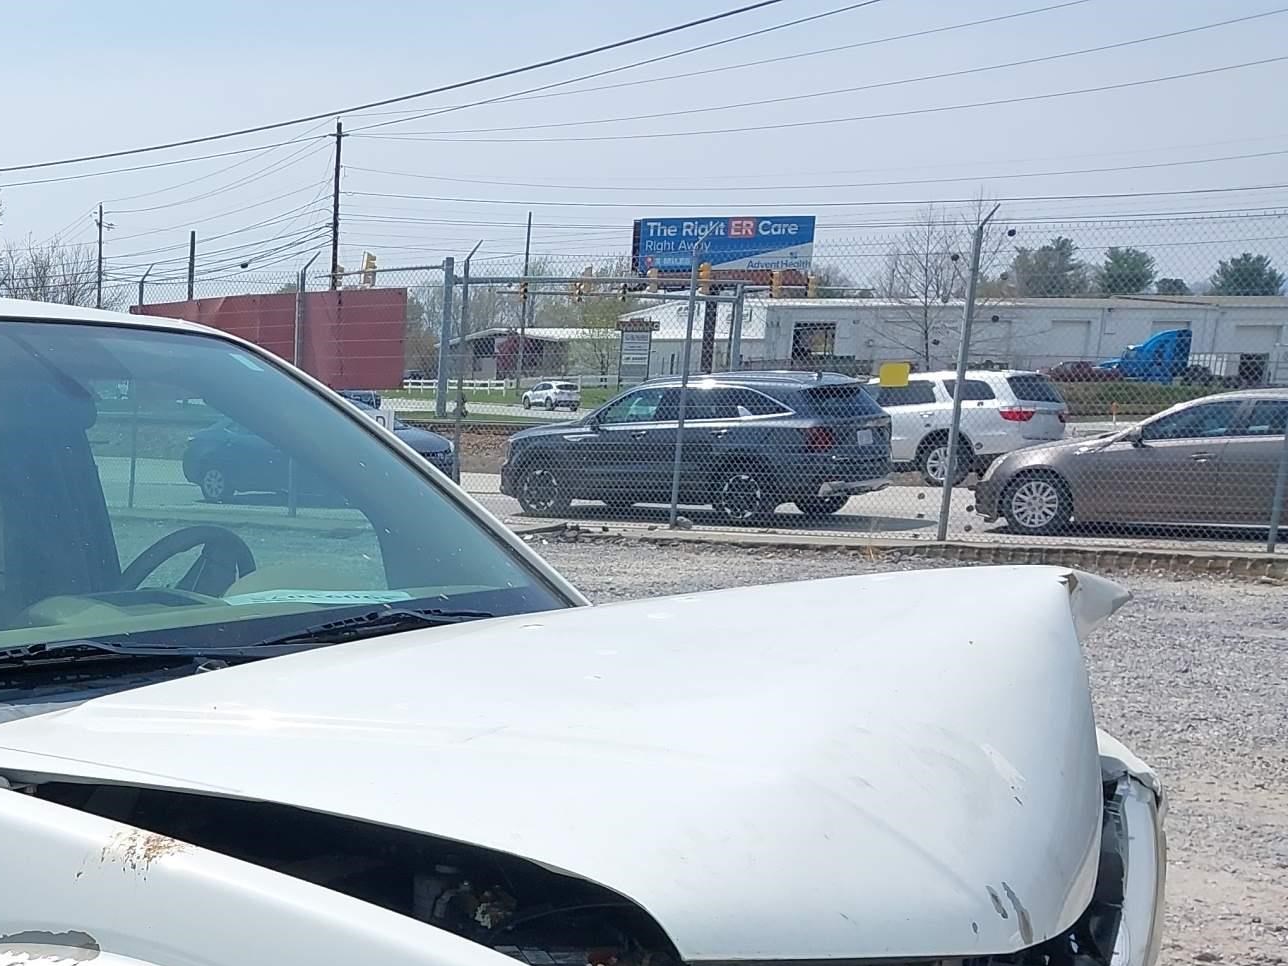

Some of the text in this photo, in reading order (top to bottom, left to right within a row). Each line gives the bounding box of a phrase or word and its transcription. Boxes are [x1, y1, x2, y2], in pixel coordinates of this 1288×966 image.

[646, 219, 799, 239] The Right ER Care
[645, 240, 675, 252] Right
[746, 259, 811, 270] AdventHealth
